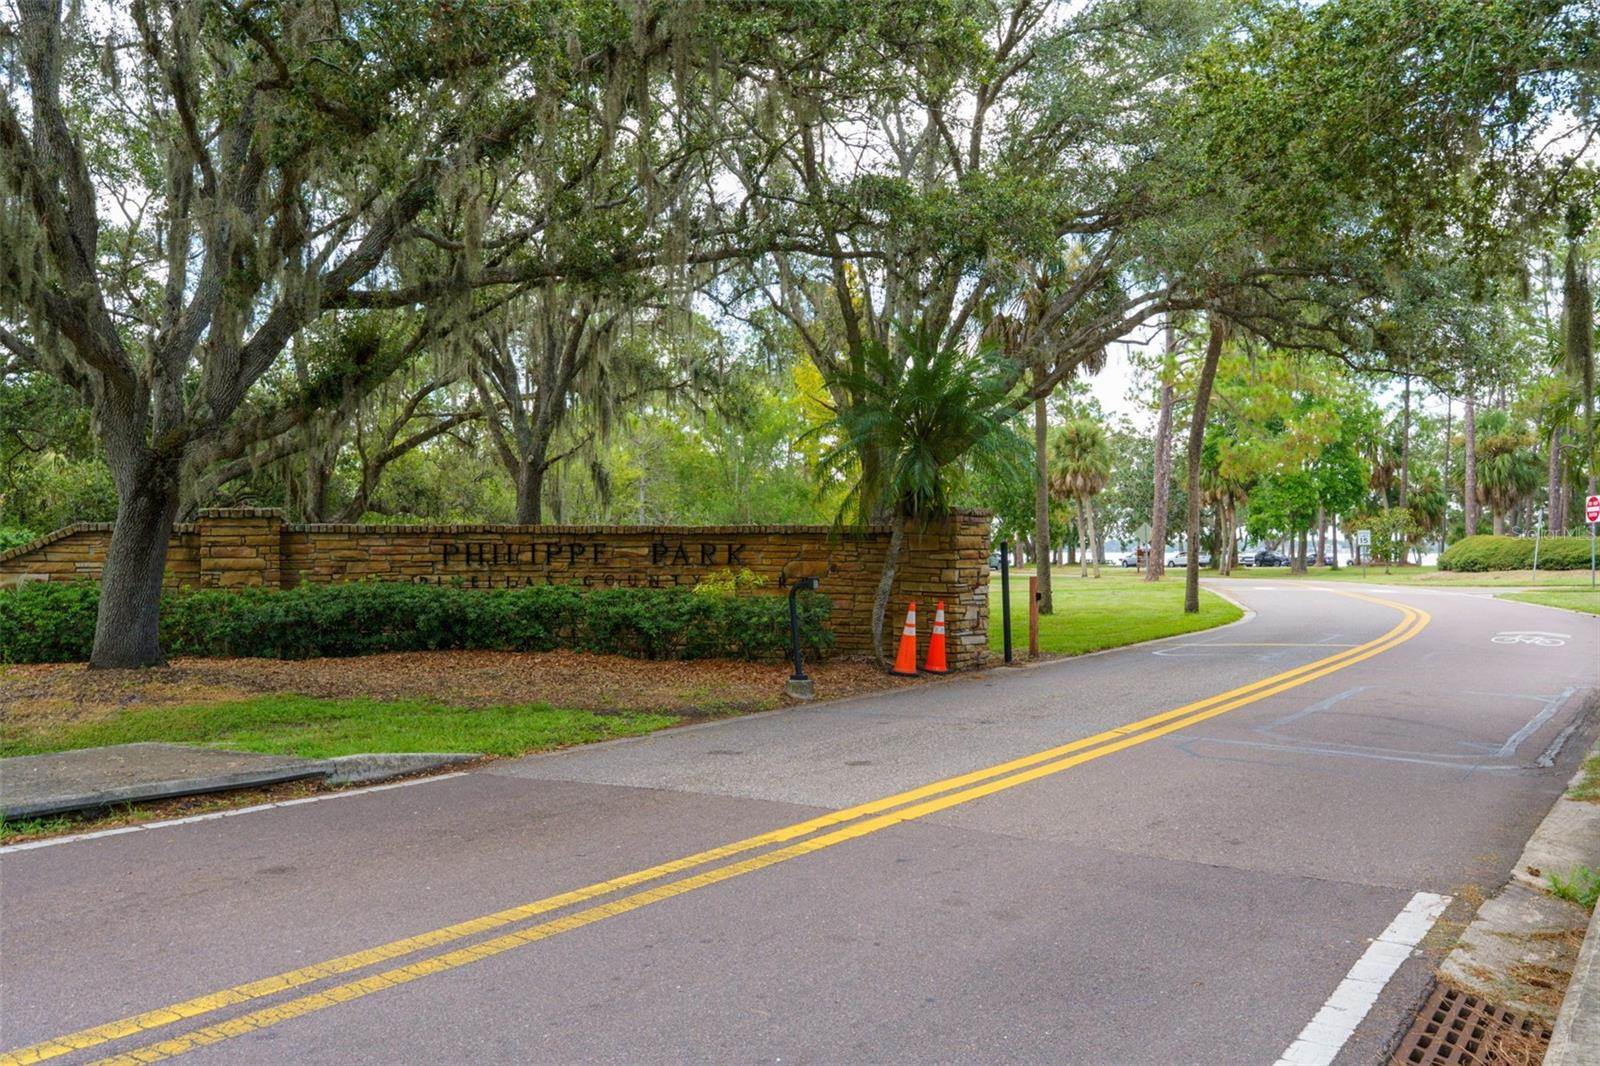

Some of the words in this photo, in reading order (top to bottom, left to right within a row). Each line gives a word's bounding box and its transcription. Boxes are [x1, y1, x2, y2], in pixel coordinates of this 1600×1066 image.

[442, 542, 607, 565] PHILIPPE
[651, 542, 746, 566] PARK
[419, 575, 555, 588] PIELLAS
[583, 575, 700, 588] COUNTY
